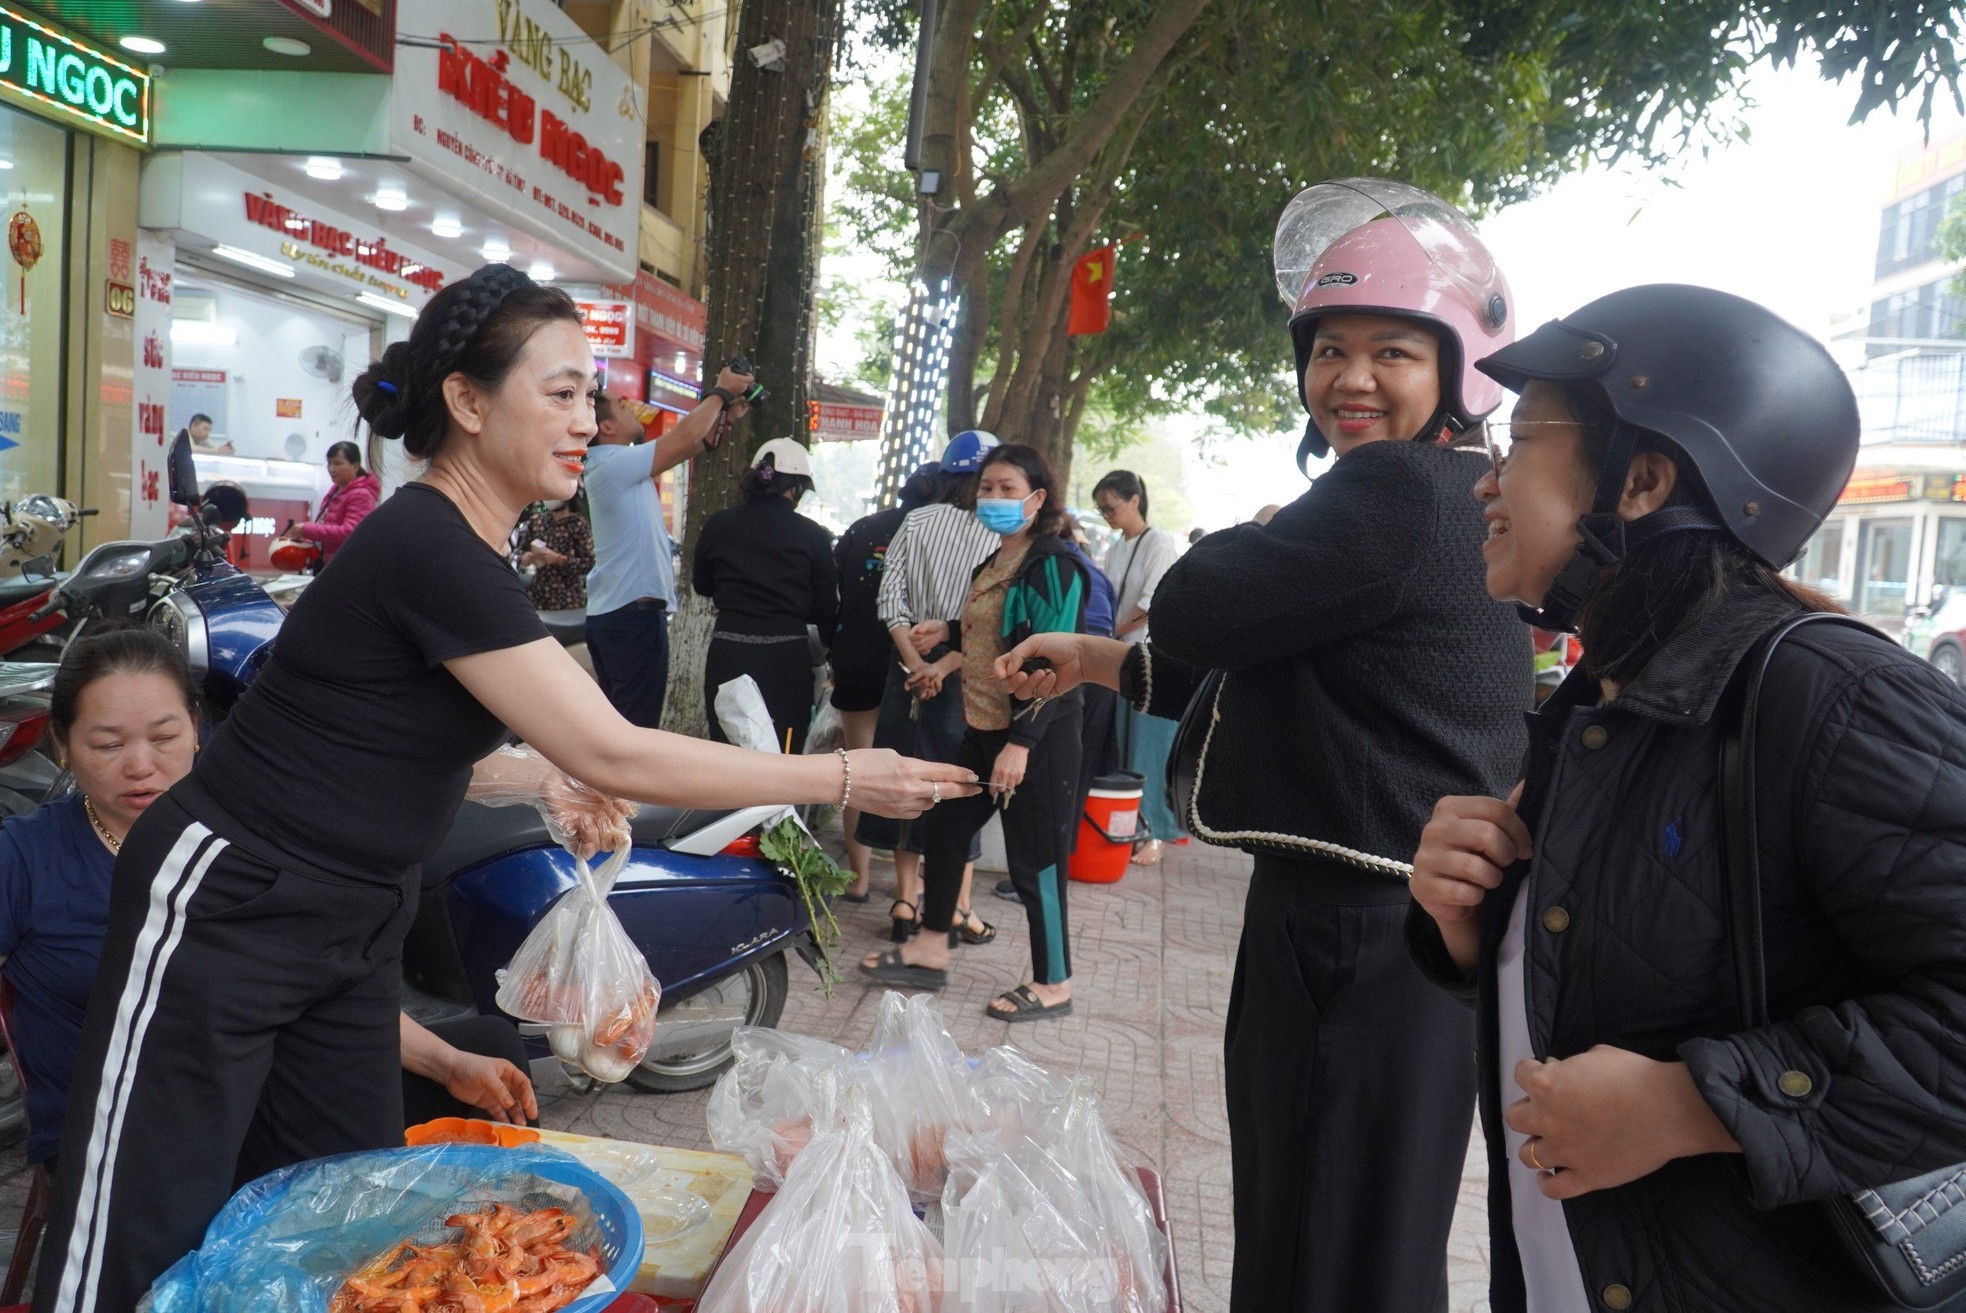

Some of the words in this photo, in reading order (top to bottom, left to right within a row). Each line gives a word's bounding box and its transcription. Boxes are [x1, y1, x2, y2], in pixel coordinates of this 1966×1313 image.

[27, 37, 137, 125] NGỌC
[557, 46, 592, 113] BẠC
[438, 32, 535, 144] KIỀU
[540, 108, 624, 207] NGỌC
[244, 192, 310, 240] VÀNG
[312, 219, 354, 258] BẠC
[110, 286, 134, 313] 06
[1321, 275, 1353, 284] GRO
[139, 394, 164, 446] vàng
[819, 416, 852, 429] HANH
[731, 927, 779, 955] KLARA
